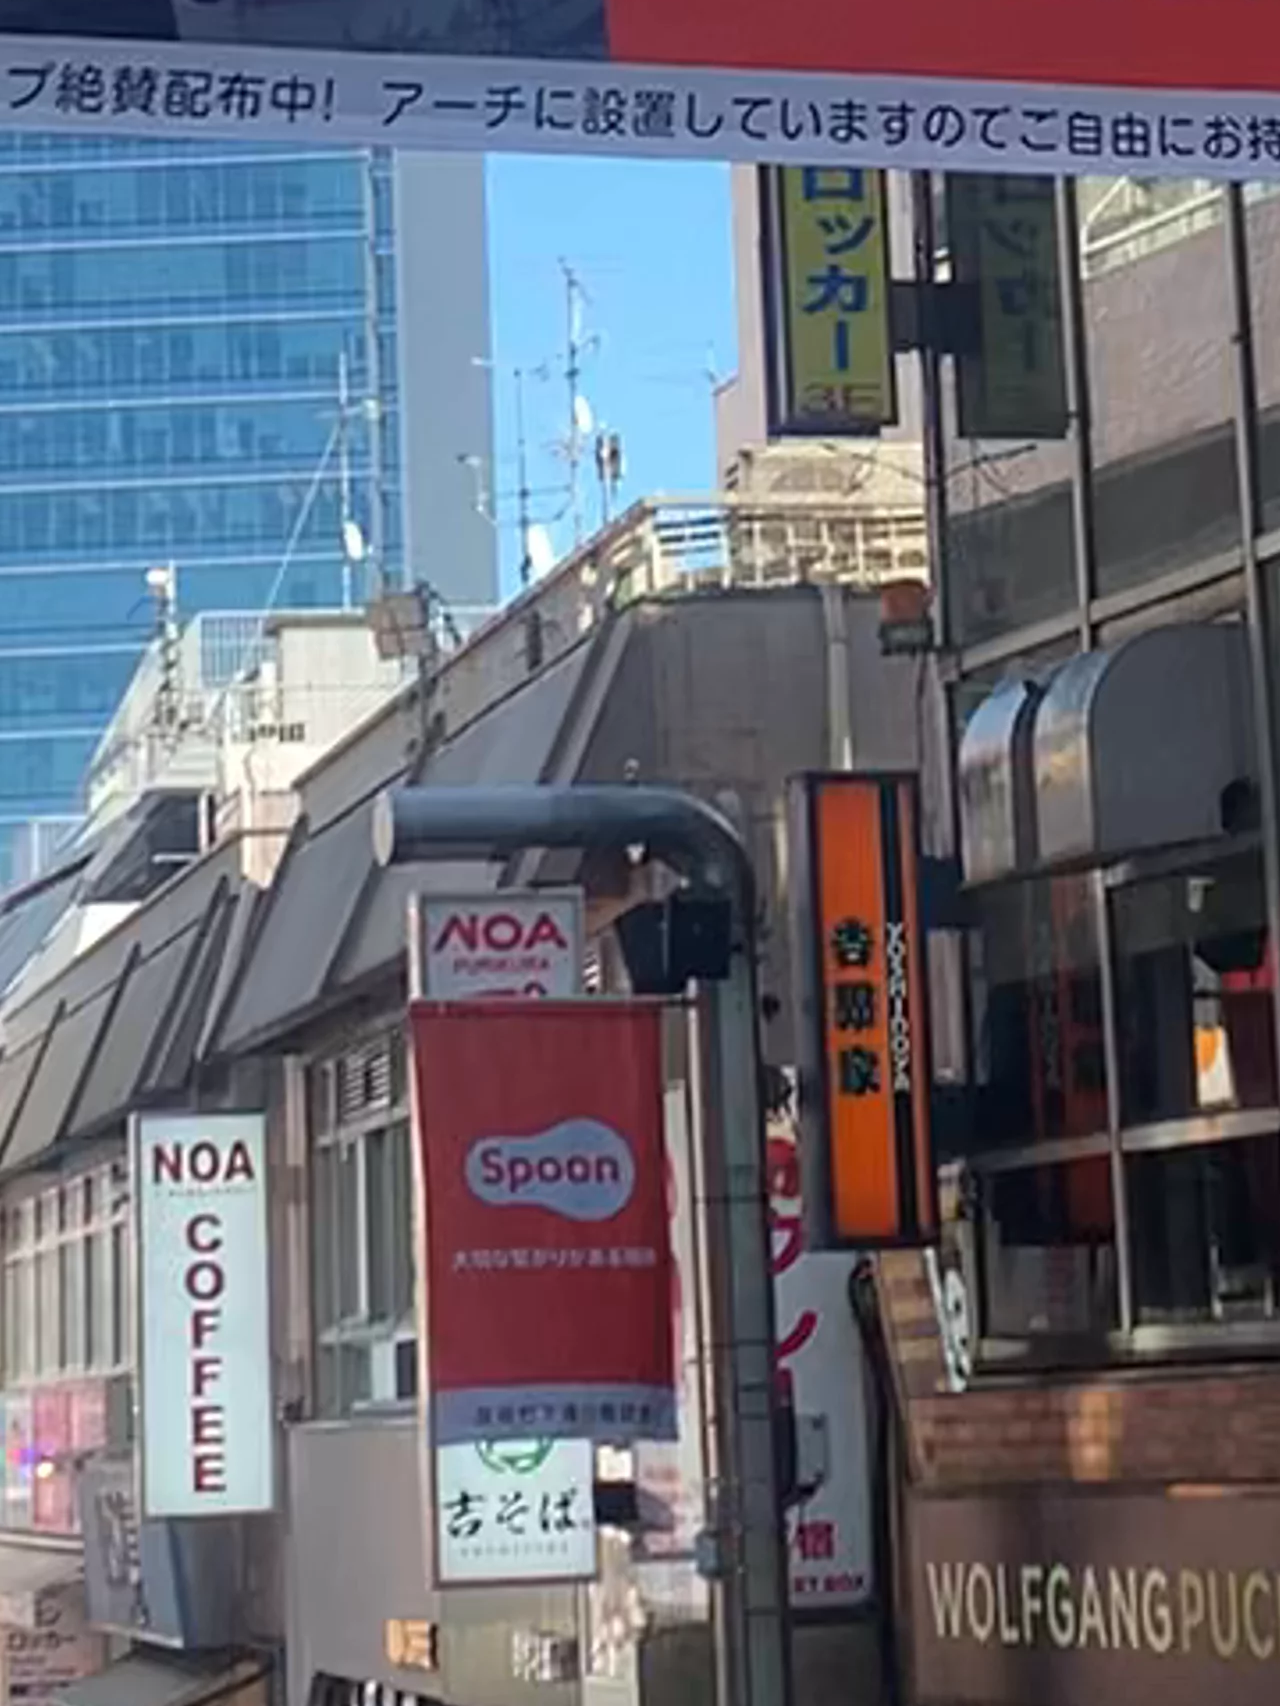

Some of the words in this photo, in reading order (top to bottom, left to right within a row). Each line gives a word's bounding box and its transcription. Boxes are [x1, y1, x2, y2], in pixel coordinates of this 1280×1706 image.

[433, 912, 569, 953] NOA
[152, 1140, 255, 1185] NOA
[480, 1147, 621, 1194] Spoon
[184, 1213, 227, 1493] COFFEE
[926, 1561, 1173, 1654] WOLFGANG
